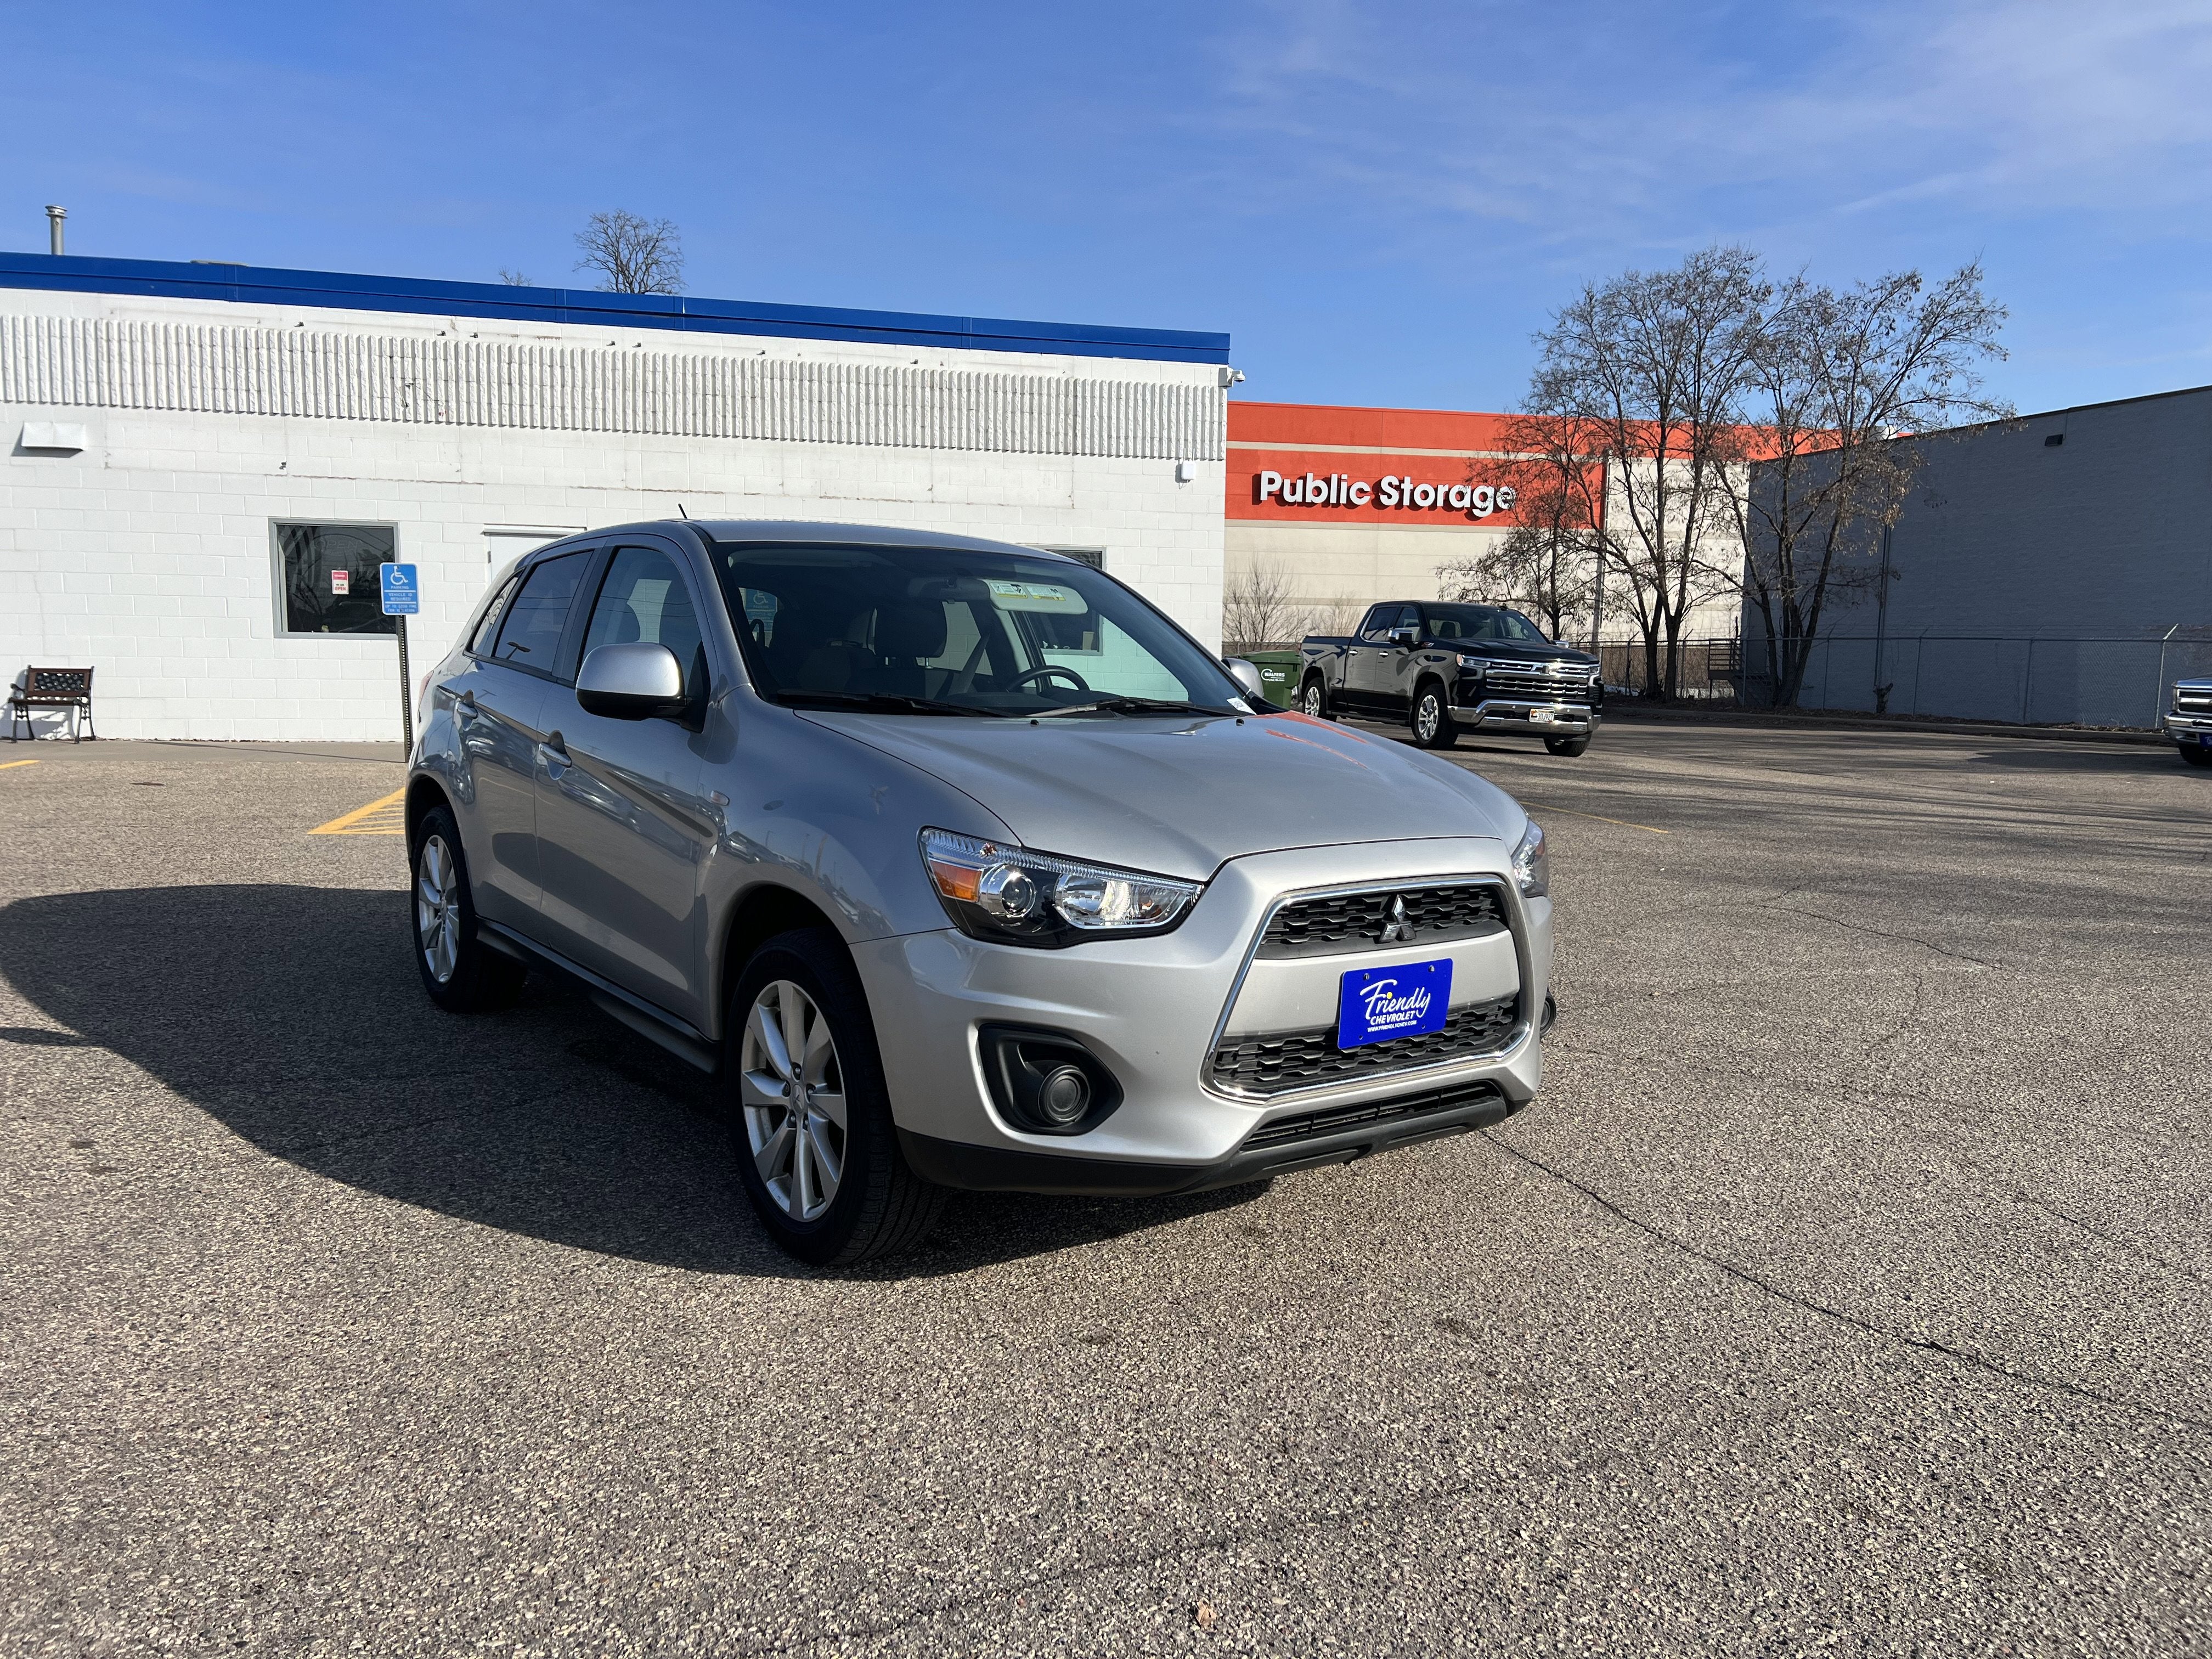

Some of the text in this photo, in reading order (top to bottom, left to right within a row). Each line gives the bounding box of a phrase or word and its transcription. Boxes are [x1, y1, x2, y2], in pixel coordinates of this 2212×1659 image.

[1260, 470, 1516, 517] Public Storage
[1359, 979, 1431, 1020] Friendly
[1370, 1011, 1416, 1025] CHEVROLET
